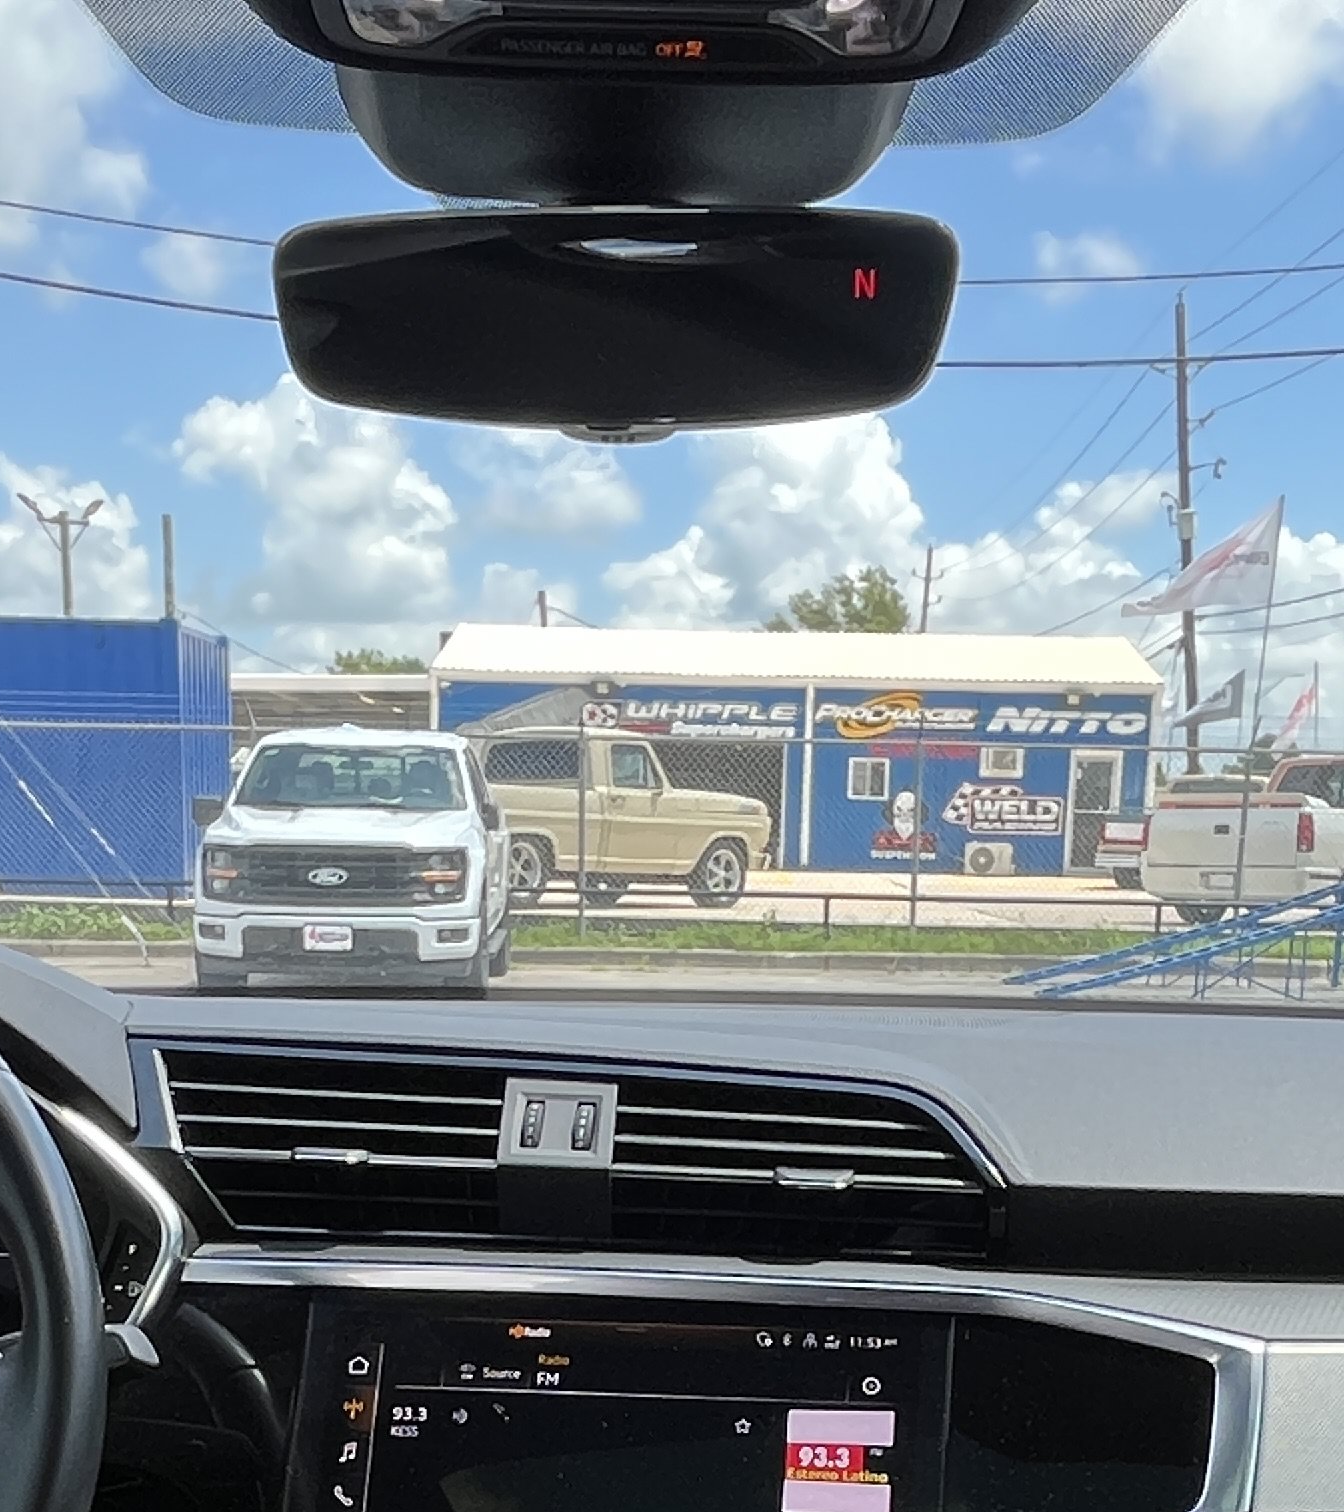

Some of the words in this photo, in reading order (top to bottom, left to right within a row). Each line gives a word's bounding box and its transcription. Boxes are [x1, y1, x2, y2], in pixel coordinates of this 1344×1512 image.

[500, 38, 585, 55] PASSENGER
[589, 42, 614, 56] AIR
[616, 42, 646, 56] BAG
[655, 42, 684, 57] OFF
[854, 268, 877, 300] N
[625, 700, 800, 723] WHIPPLE
[973, 799, 1059, 821] WELD
[538, 1354, 570, 1366] Radio
[482, 1366, 522, 1380] Source
[536, 1372, 560, 1386] FM
[392, 1406, 428, 1421] 93.3
[798, 1446, 850, 1468] 93.3
[787, 1466, 839, 1481] Estereo
[842, 1470, 890, 1484] Latino
